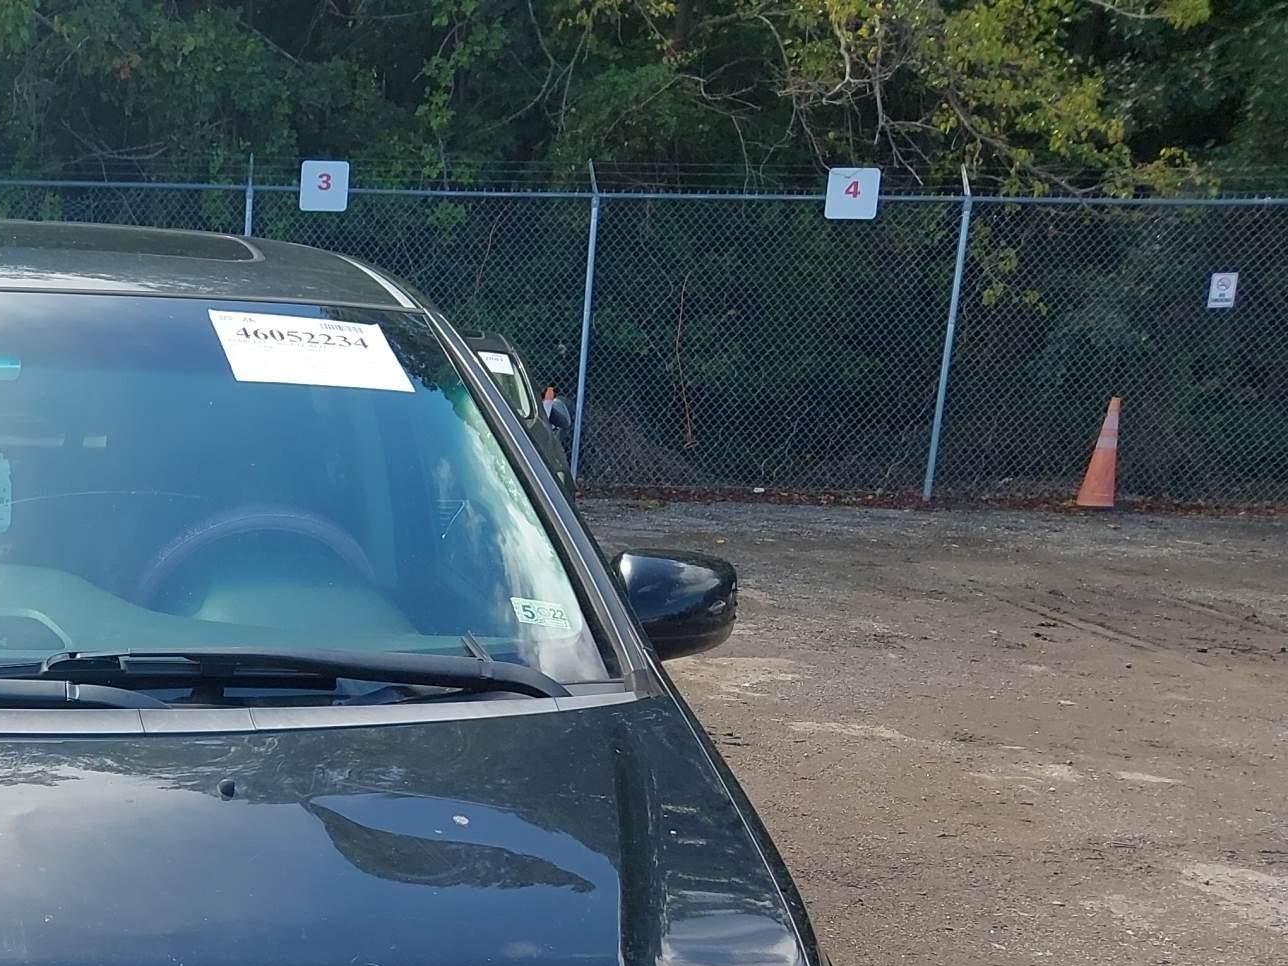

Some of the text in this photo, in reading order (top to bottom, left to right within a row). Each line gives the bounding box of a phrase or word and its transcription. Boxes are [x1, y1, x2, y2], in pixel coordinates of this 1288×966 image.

[317, 173, 332, 191] 3
[844, 180, 861, 198] 4
[236, 326, 369, 349] 46052234
[522, 604, 567, 621] 5 22
